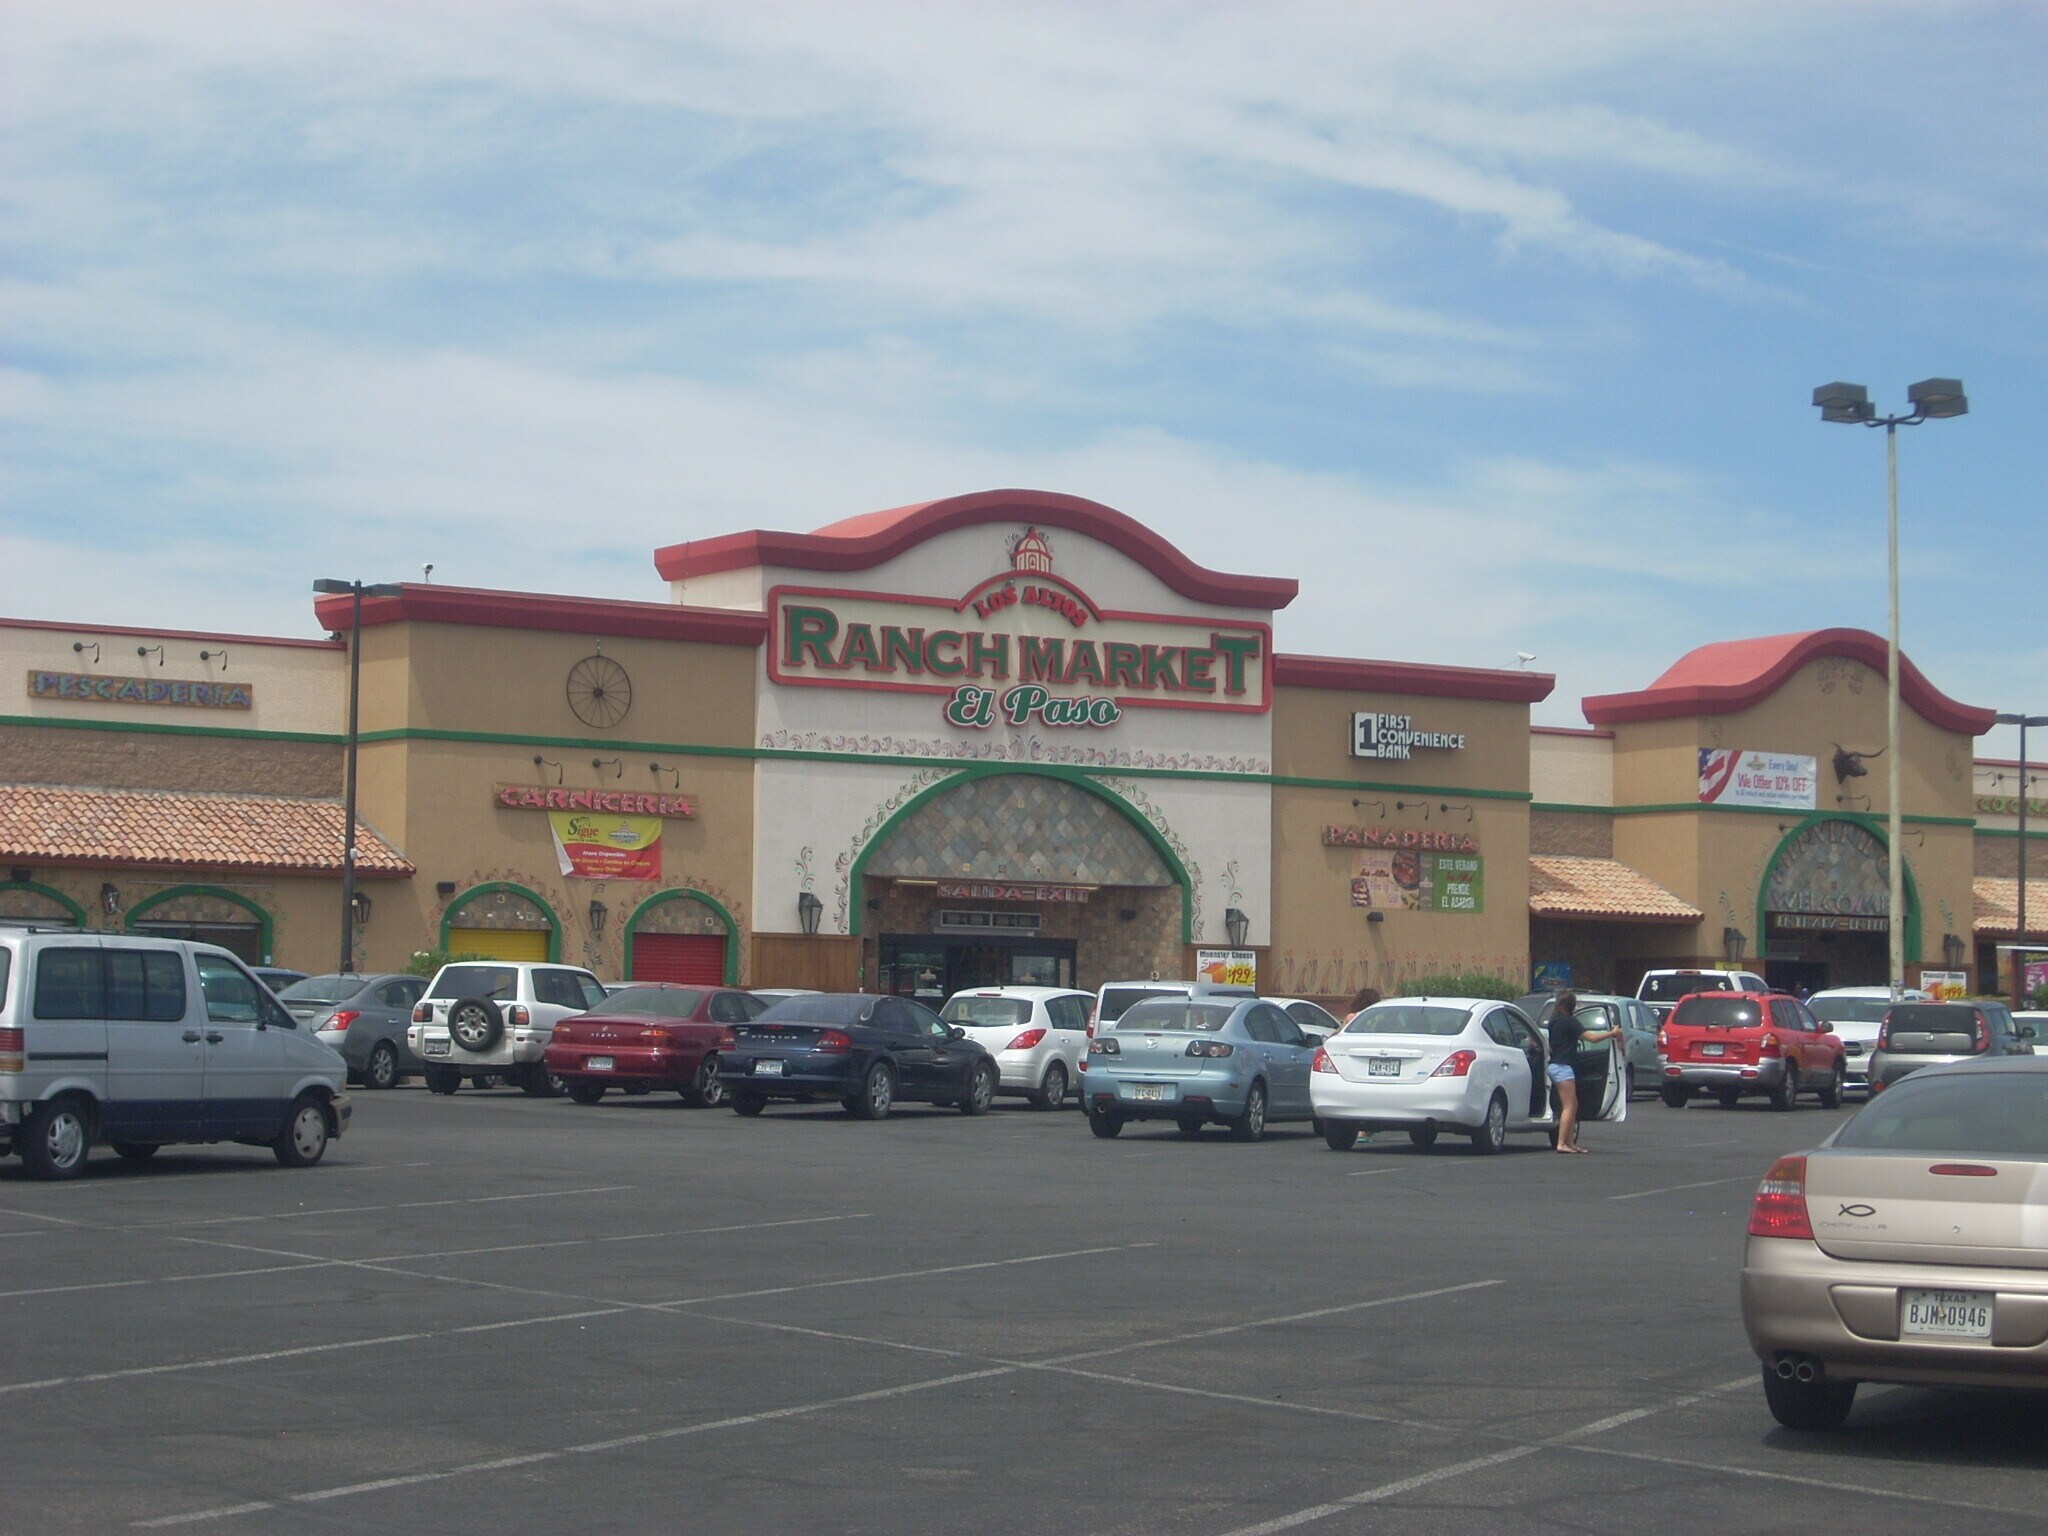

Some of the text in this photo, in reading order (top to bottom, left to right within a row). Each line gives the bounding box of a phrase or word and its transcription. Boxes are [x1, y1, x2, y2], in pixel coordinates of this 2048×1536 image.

[973, 585, 1088, 626] LOS ALTOS
[782, 605, 1260, 695] RANCH MARKET
[34, 671, 250, 706] PESCADERIA
[943, 684, 1123, 729] El Paso
[1378, 713, 1411, 730] FIRST
[1377, 729, 1466, 749] CONVENIENCE
[1377, 744, 1411, 760] BANK
[1769, 759, 1785, 771] Every
[1738, 773, 1808, 792] We Offer 10% OFF
[500, 785, 692, 816] CARNICERIA
[567, 817, 599, 839] Sigue
[1328, 824, 1478, 851] PANADERIA
[1439, 859, 1478, 871] ESTE VERANO
[1447, 883, 1470, 895] PRENDE
[1442, 896, 1449, 907] EL
[1934, 1293, 1967, 1303] TEXAS
